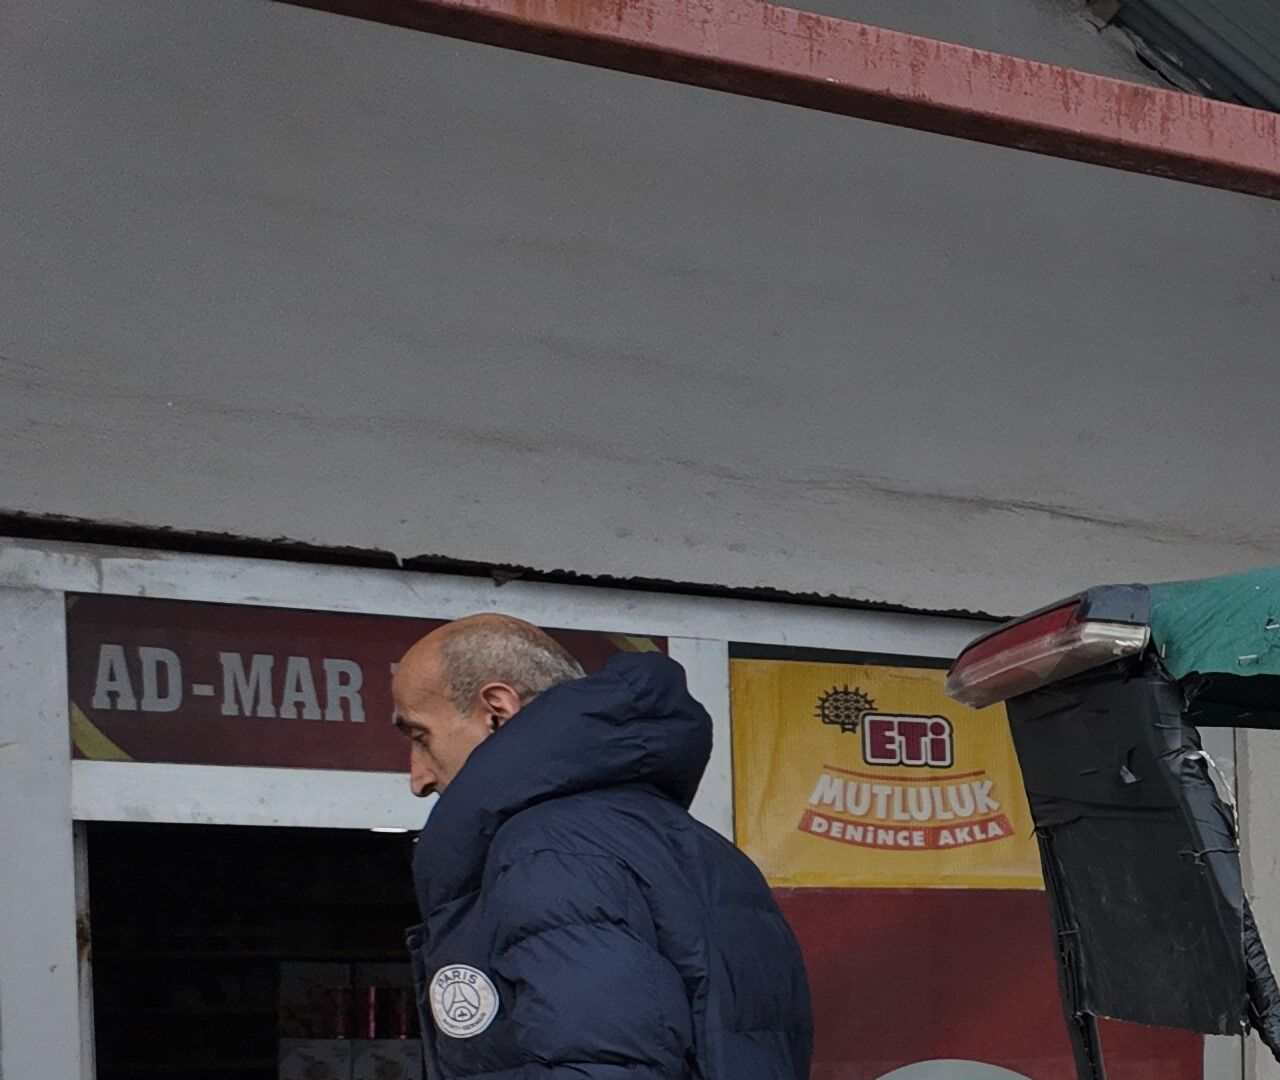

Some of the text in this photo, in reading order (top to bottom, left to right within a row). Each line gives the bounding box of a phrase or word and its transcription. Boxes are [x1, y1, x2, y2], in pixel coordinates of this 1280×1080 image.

[92, 643, 365, 723] AD-MAR
[811, 775, 1000, 820] MUTLULUK
[938, 821, 1003, 845] AKLA
[438, 970, 478, 989] PARIS
